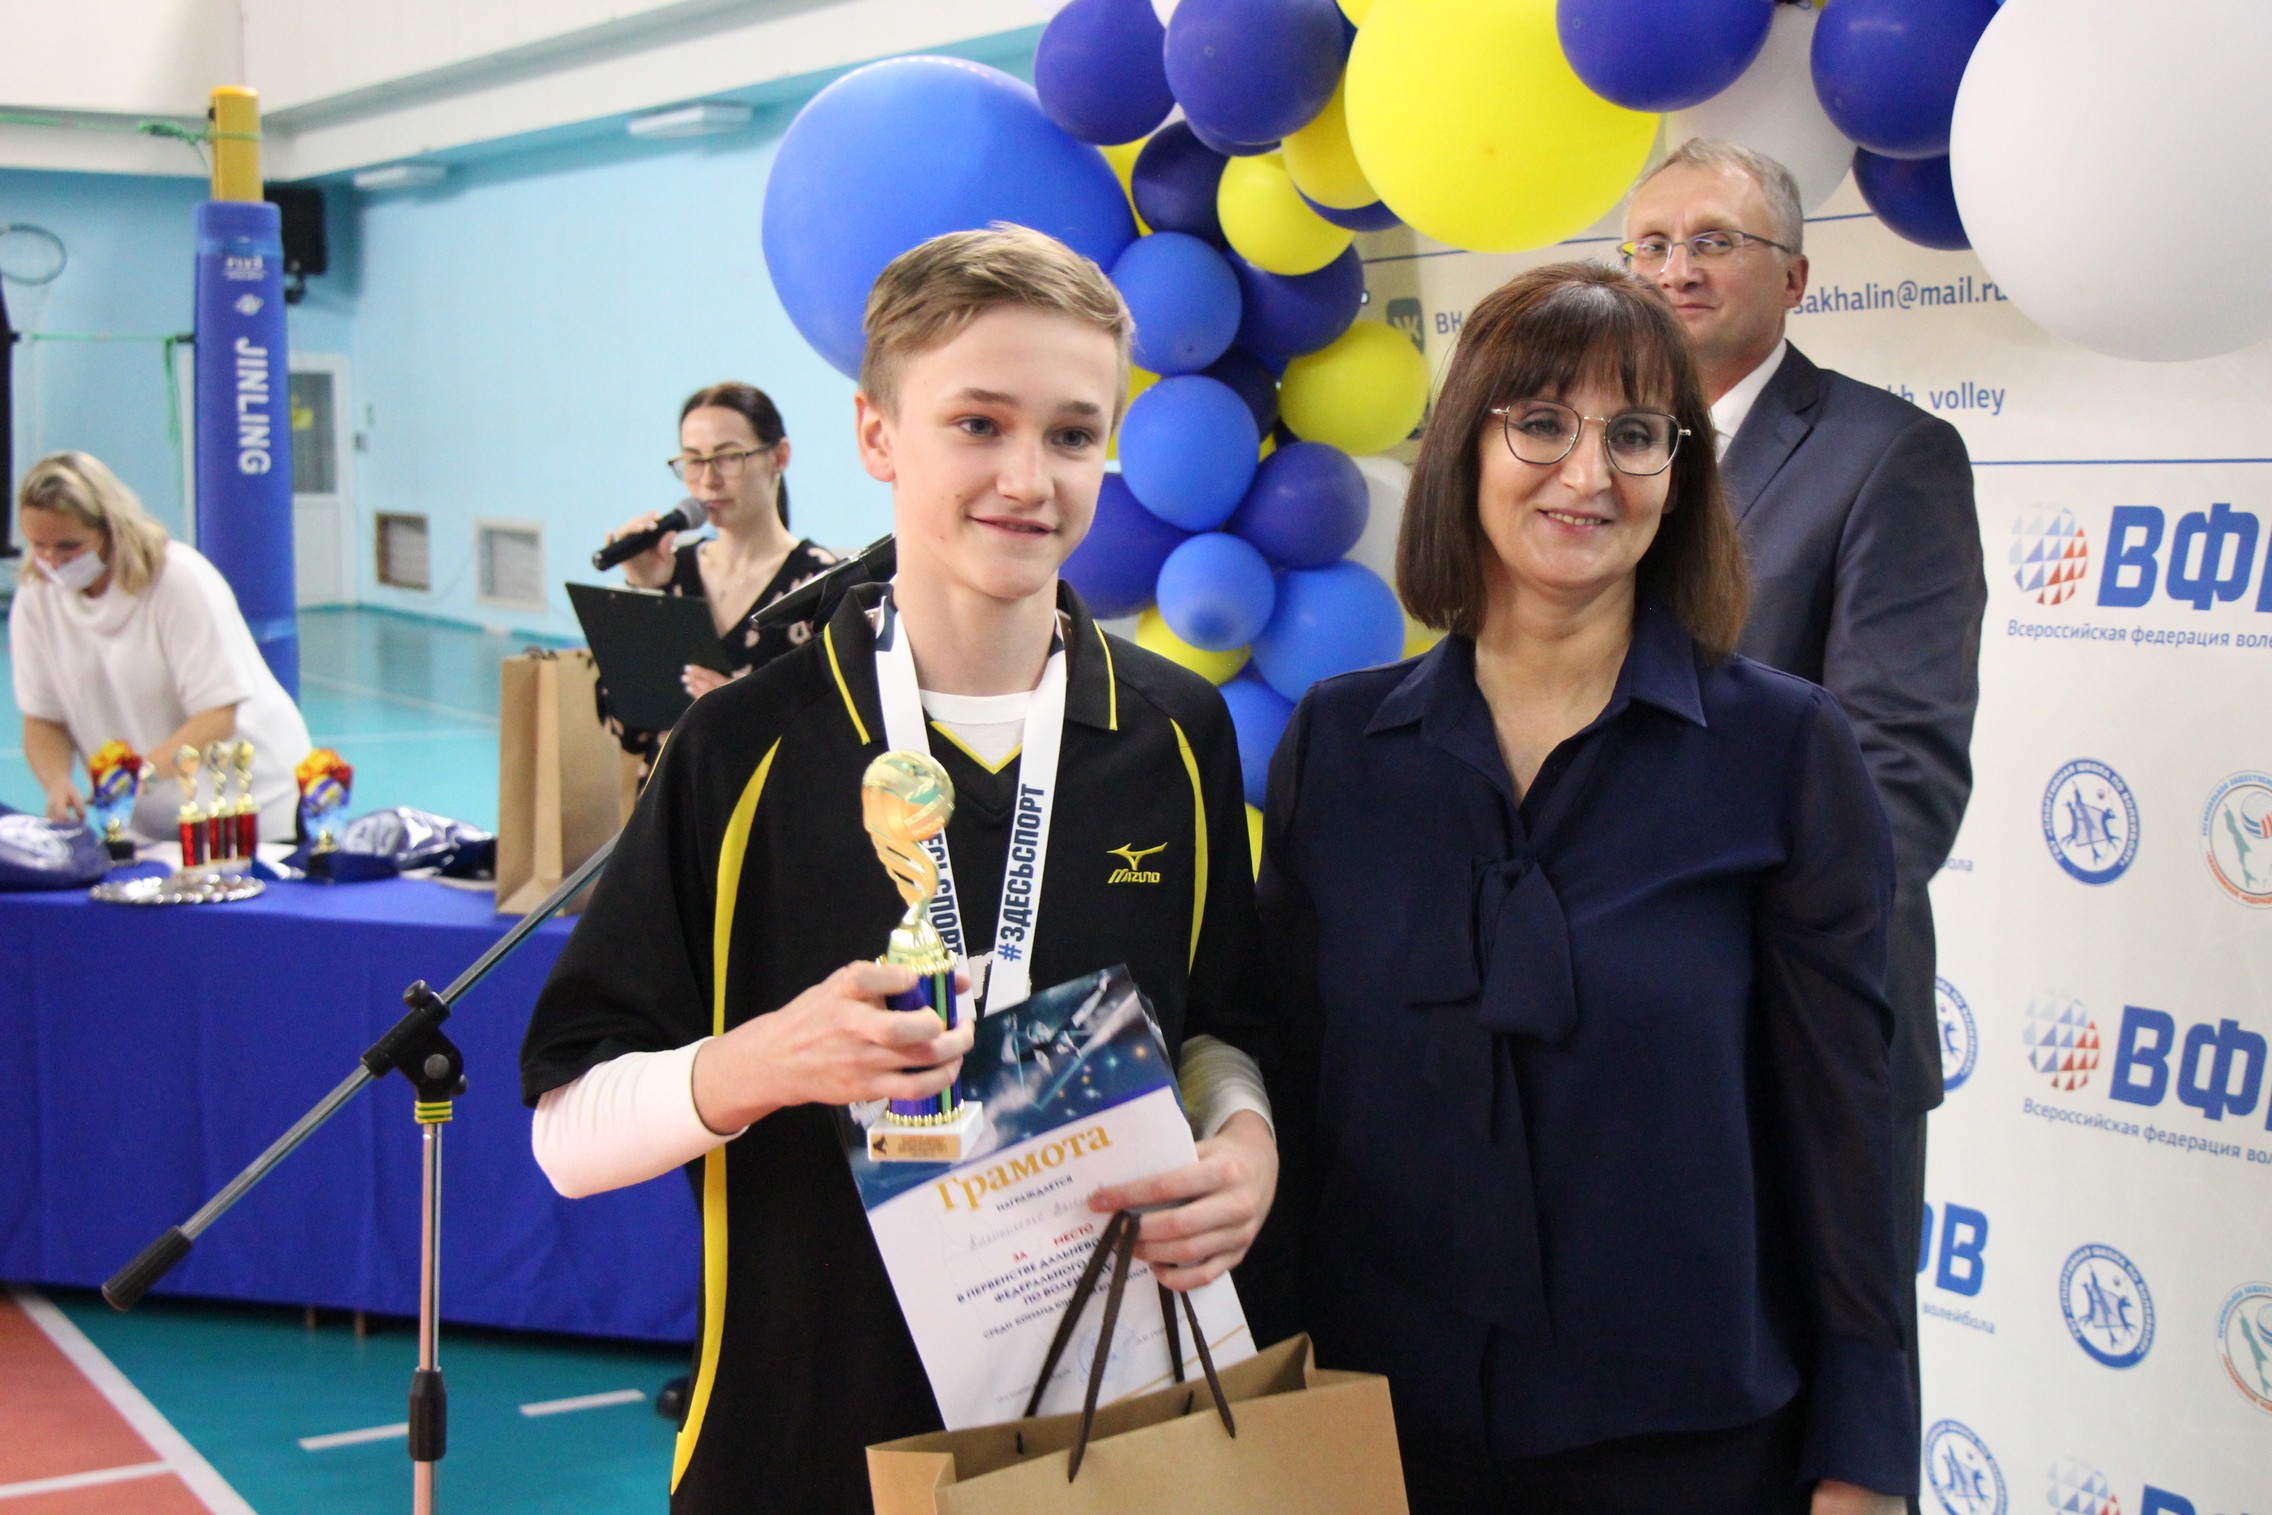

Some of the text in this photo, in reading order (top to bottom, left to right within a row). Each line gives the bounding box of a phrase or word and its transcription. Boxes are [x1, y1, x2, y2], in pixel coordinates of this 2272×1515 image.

[235, 337, 272, 476] JINLING
[2097, 503, 2272, 612] ВФ
[2007, 619, 2127, 642] Всероссийская
[2131, 624, 2230, 648] федерация
[997, 784, 1045, 962] #ЗДЕСЬСПОРТ
[2109, 1004, 2272, 1131] ВФ
[2023, 1097, 2140, 1137] Всероссийская
[2143, 1123, 2242, 1159] федерация
[935, 1124, 1113, 1214] Грамота
[967, 1263, 1037, 1301] ПЕРВЕНСТВЕ
[1039, 1237, 1101, 1269] ДАЛЬНЕВО
[1053, 1222, 1095, 1247] МЕСТО
[1922, 1302, 1996, 1335] волейбола
